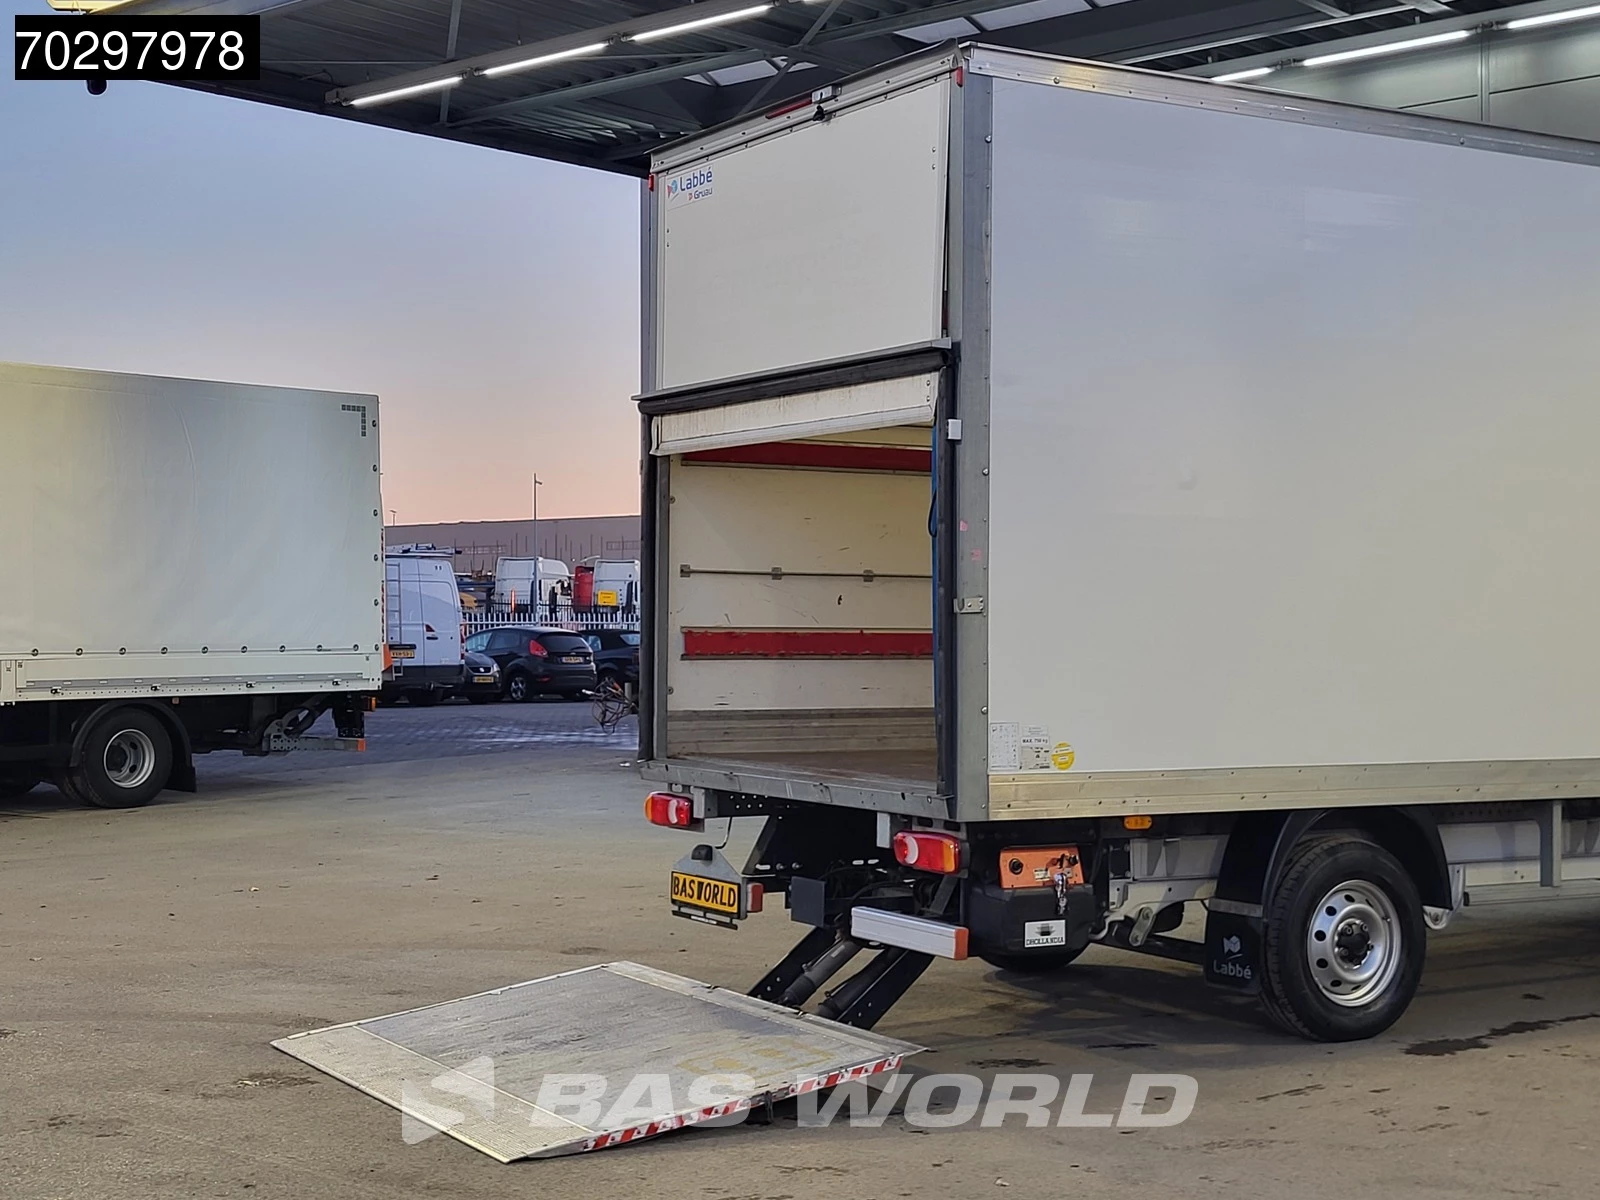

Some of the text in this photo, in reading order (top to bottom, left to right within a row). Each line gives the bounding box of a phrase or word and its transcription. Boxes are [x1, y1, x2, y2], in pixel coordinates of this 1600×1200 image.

[680, 166, 713, 192] Labbé
[693, 187, 713, 200] Gruau
[1213, 960, 1252, 979] Labbé
